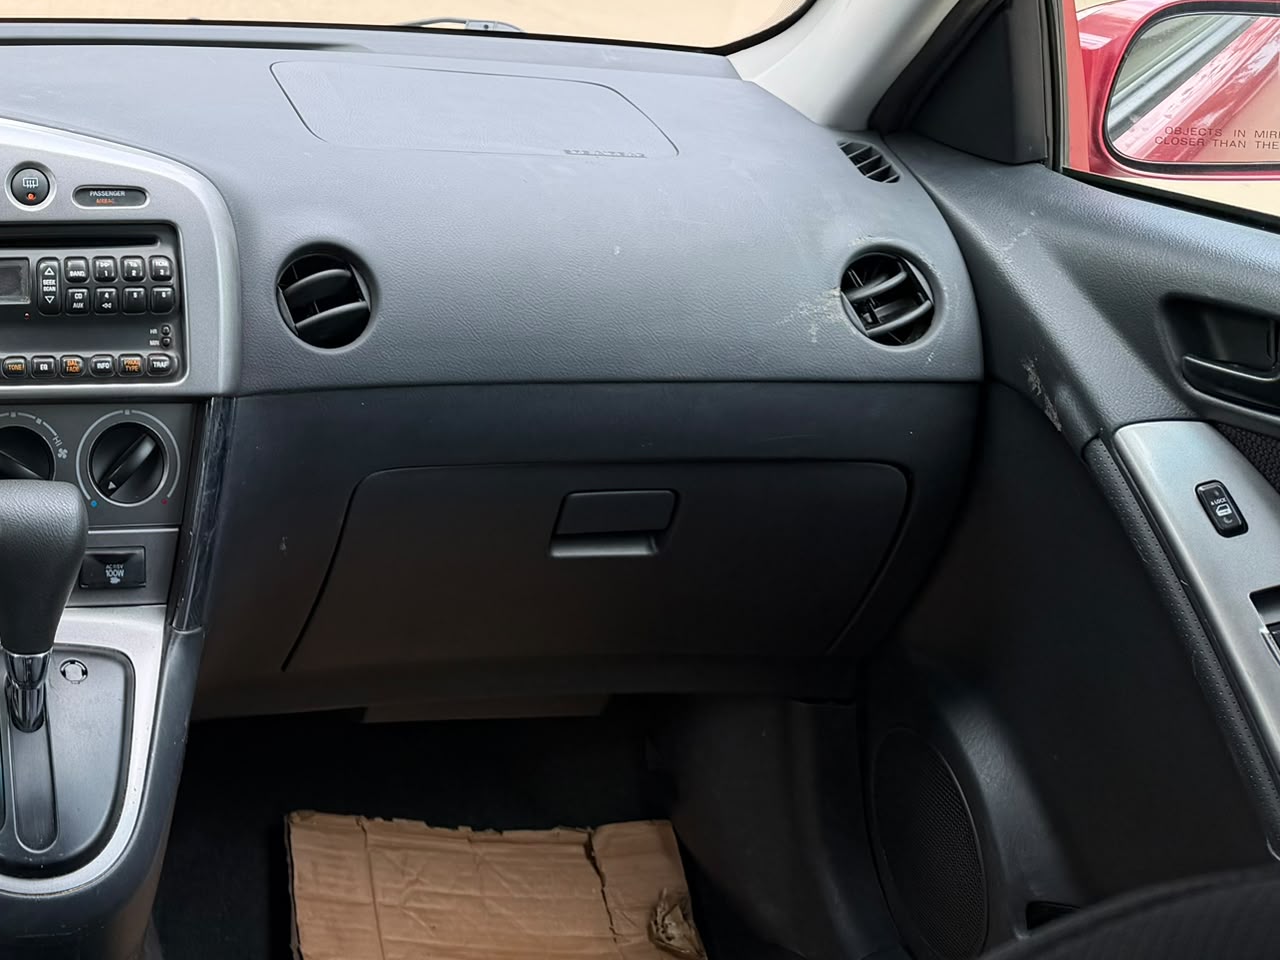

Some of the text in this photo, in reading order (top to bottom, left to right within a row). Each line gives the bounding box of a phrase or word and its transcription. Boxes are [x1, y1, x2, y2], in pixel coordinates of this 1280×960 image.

[1164, 126, 1223, 137] OBJECTS
[1233, 129, 1246, 138] IN
[1154, 136, 1205, 147] CLOSER
[1213, 139, 1246, 149] THAN
[52, 435, 63, 447] HI
